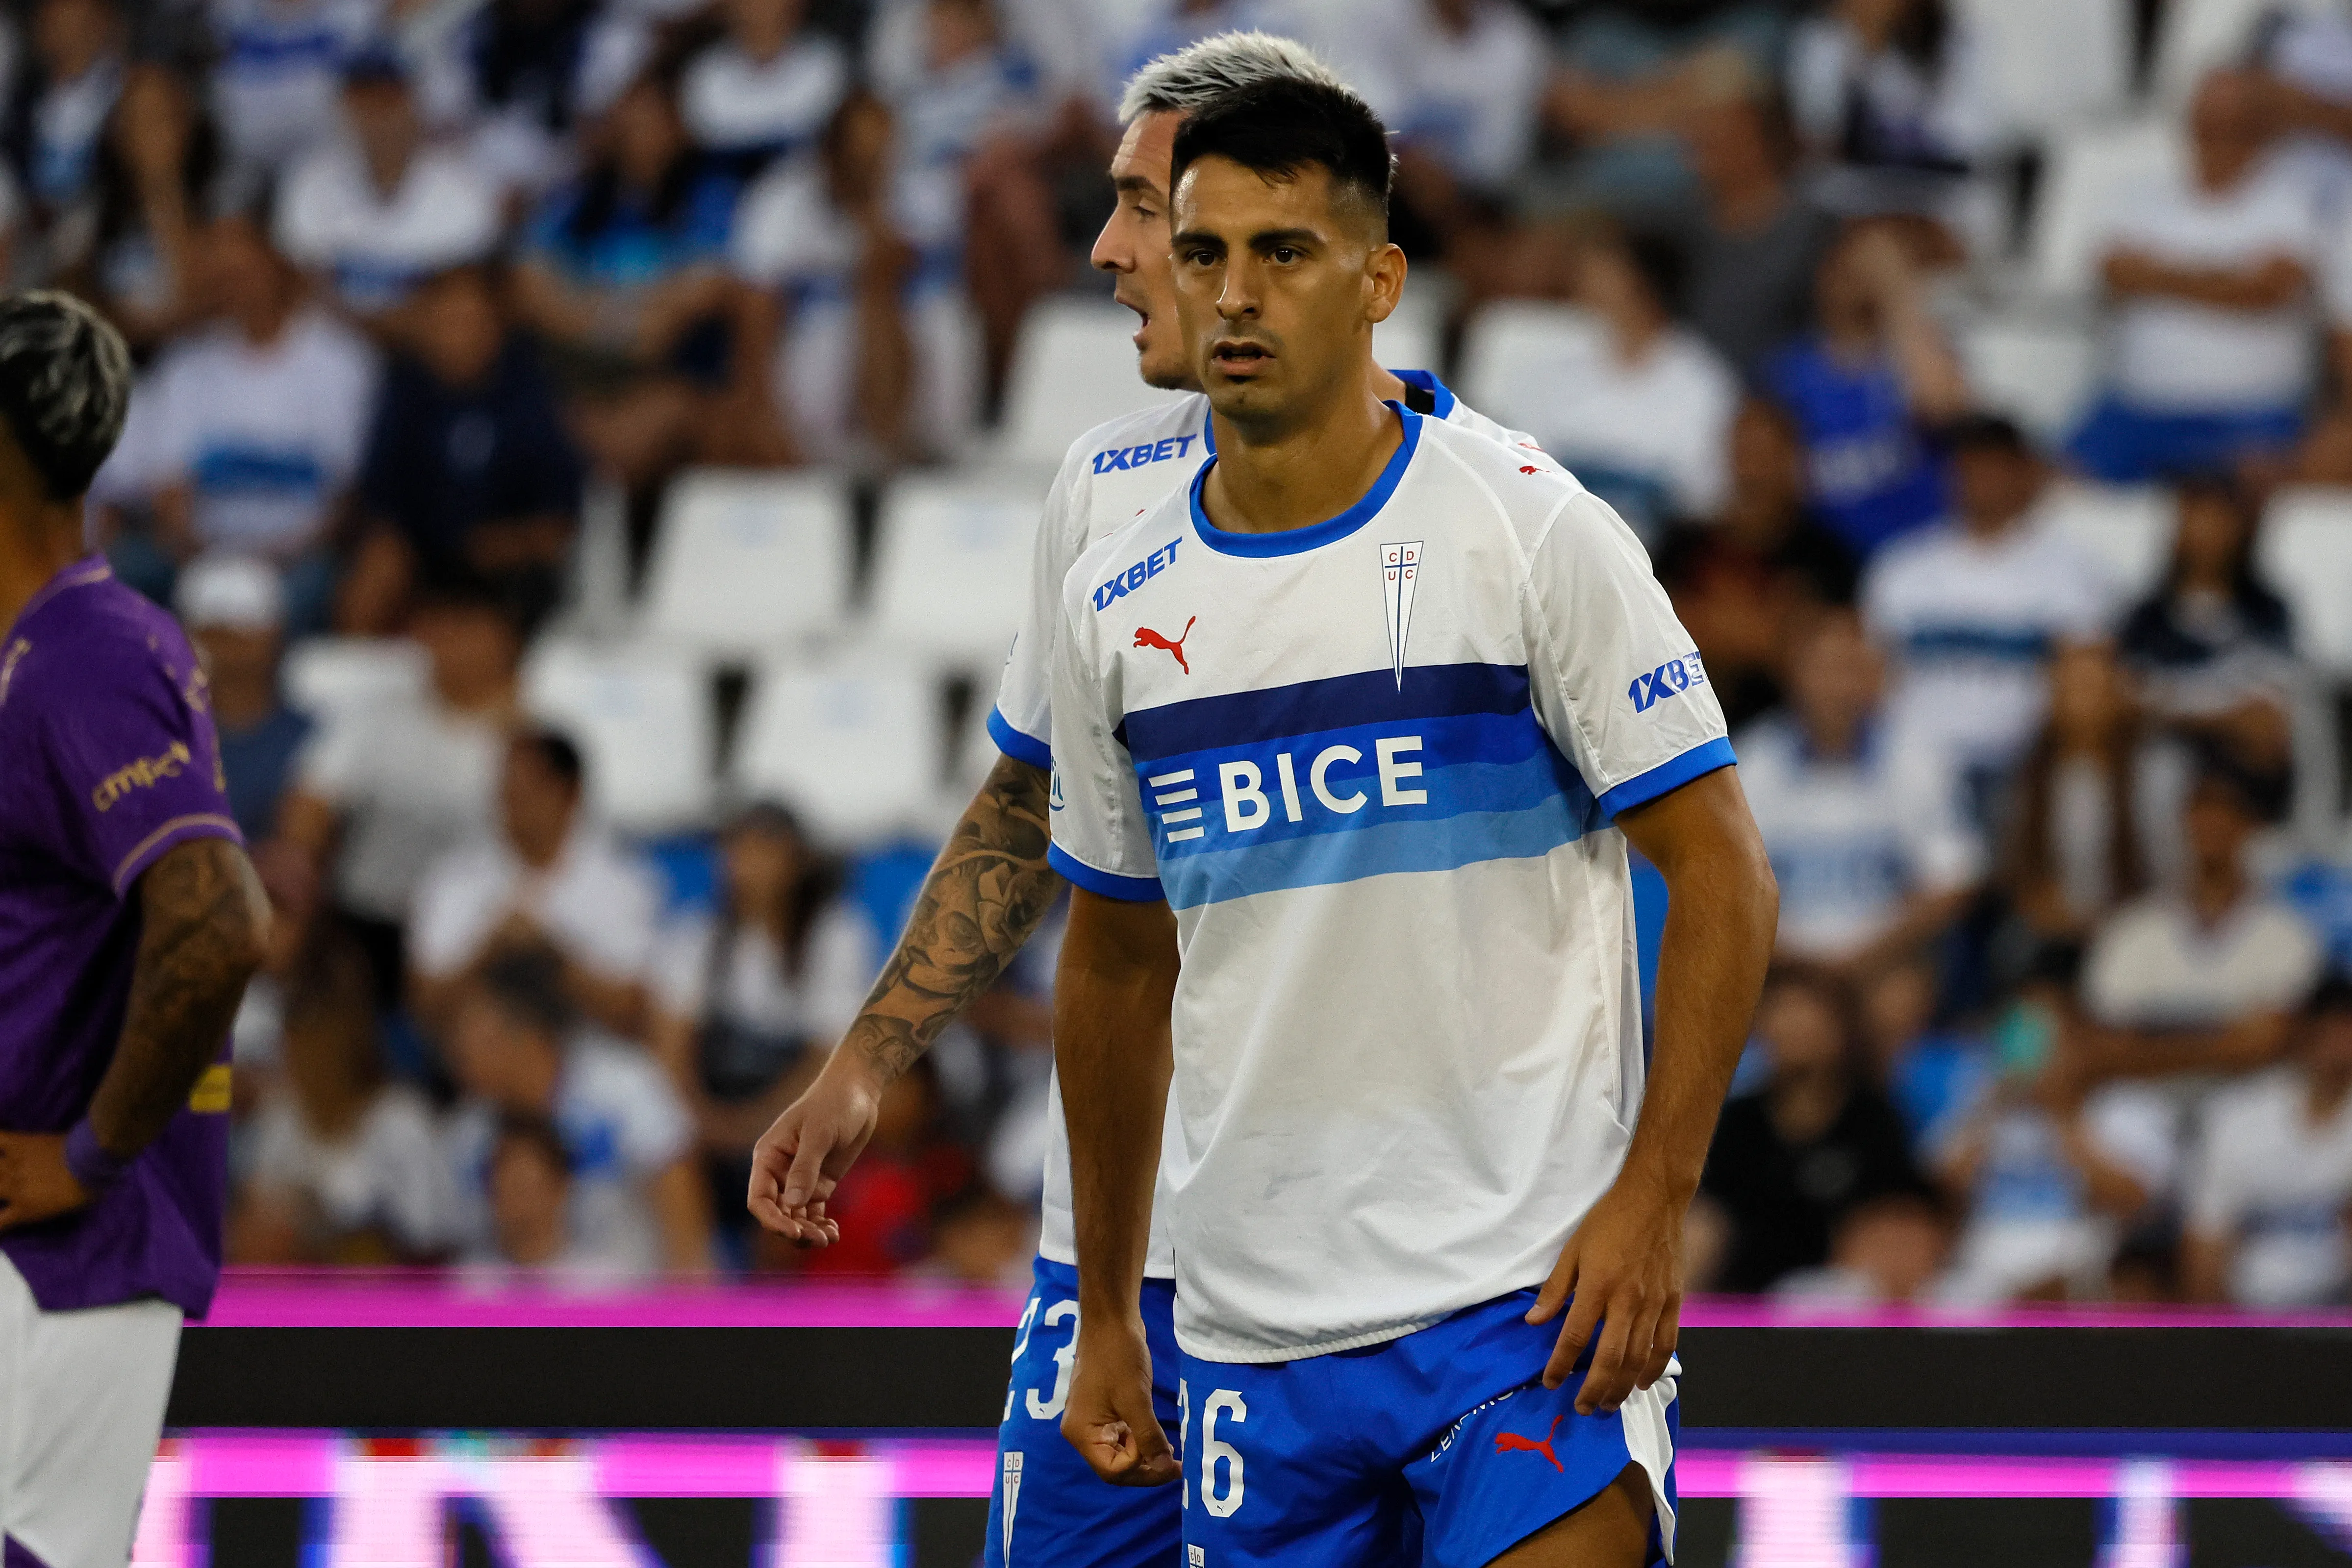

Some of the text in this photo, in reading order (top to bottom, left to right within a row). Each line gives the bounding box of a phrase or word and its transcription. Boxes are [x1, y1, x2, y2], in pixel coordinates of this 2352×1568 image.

[1092, 434, 1197, 474] 1XBET
[1092, 536, 1182, 611] 1XBET
[1628, 651, 1704, 714] 1XBE
[1219, 736, 1427, 833] BICE
